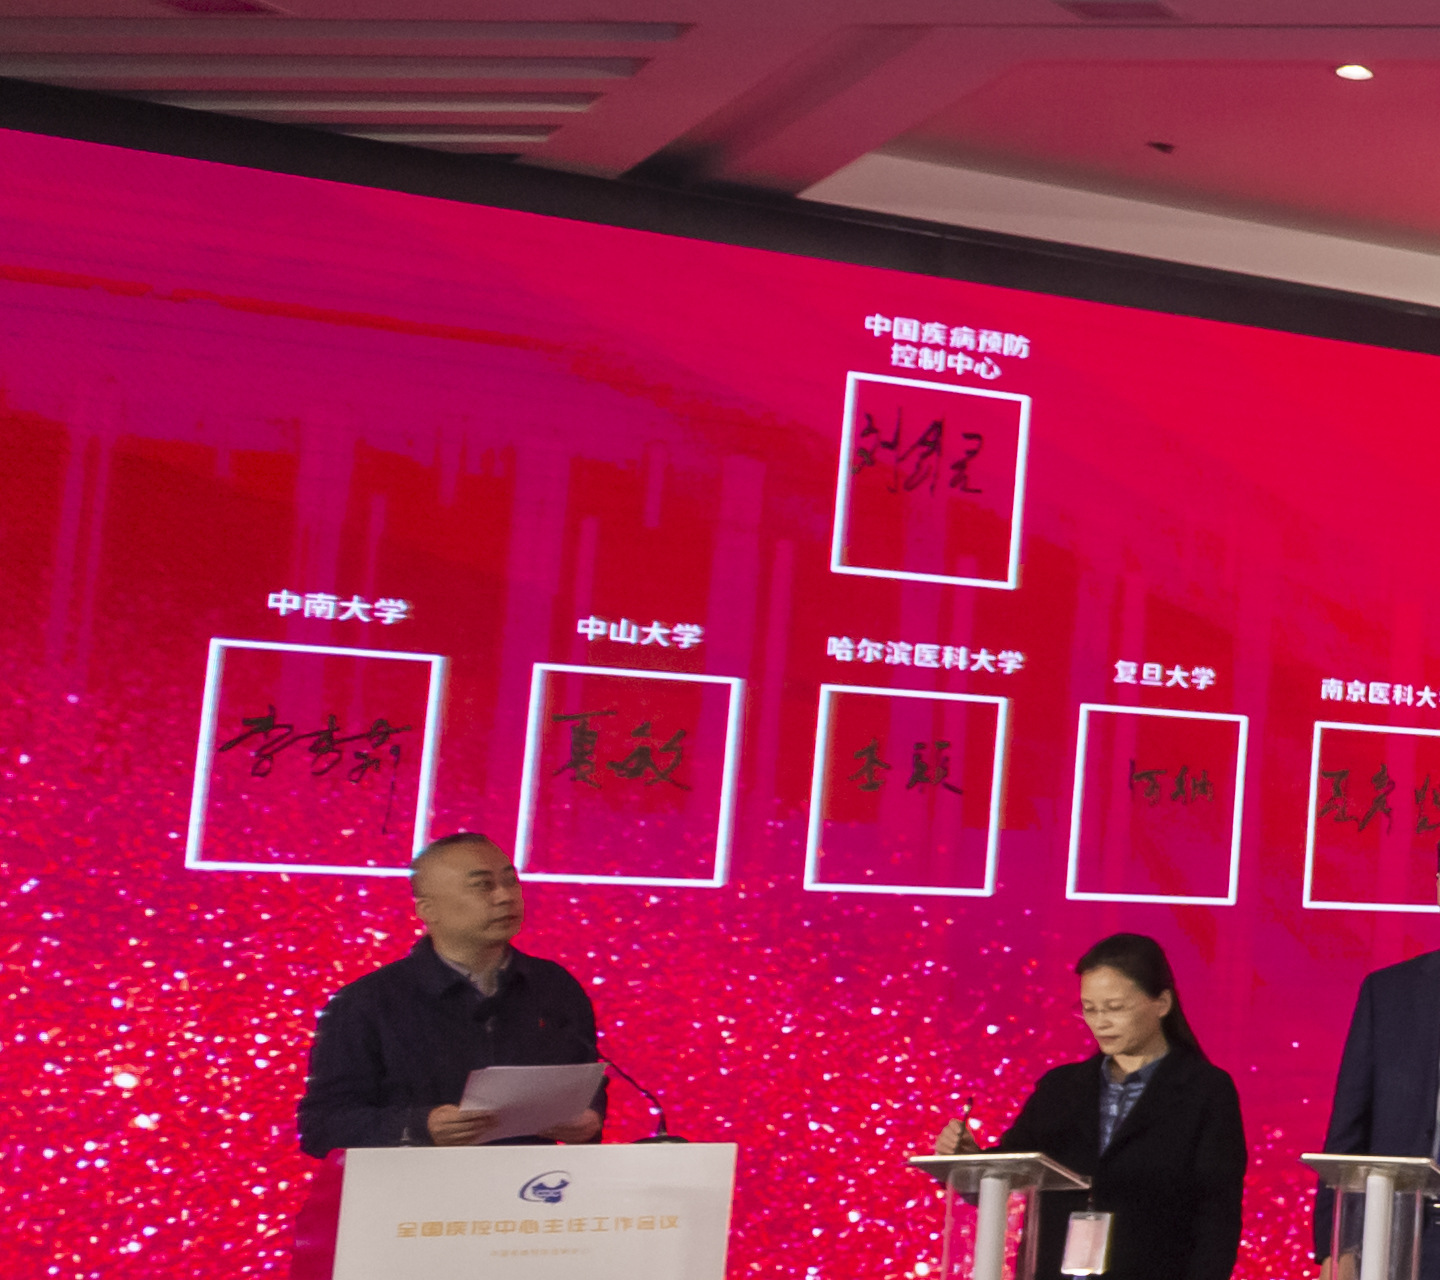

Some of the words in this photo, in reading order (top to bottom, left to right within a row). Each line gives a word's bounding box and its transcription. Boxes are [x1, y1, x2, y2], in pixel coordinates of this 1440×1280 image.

[864, 313, 1031, 359] 中国疾病预防
[890, 342, 1002, 380] 控制中心
[267, 589, 410, 625] 中南大学
[577, 616, 704, 649] 中山大学
[826, 635, 1026, 675] 哈尔滨医科大学
[1112, 659, 1216, 690] 复旦大学
